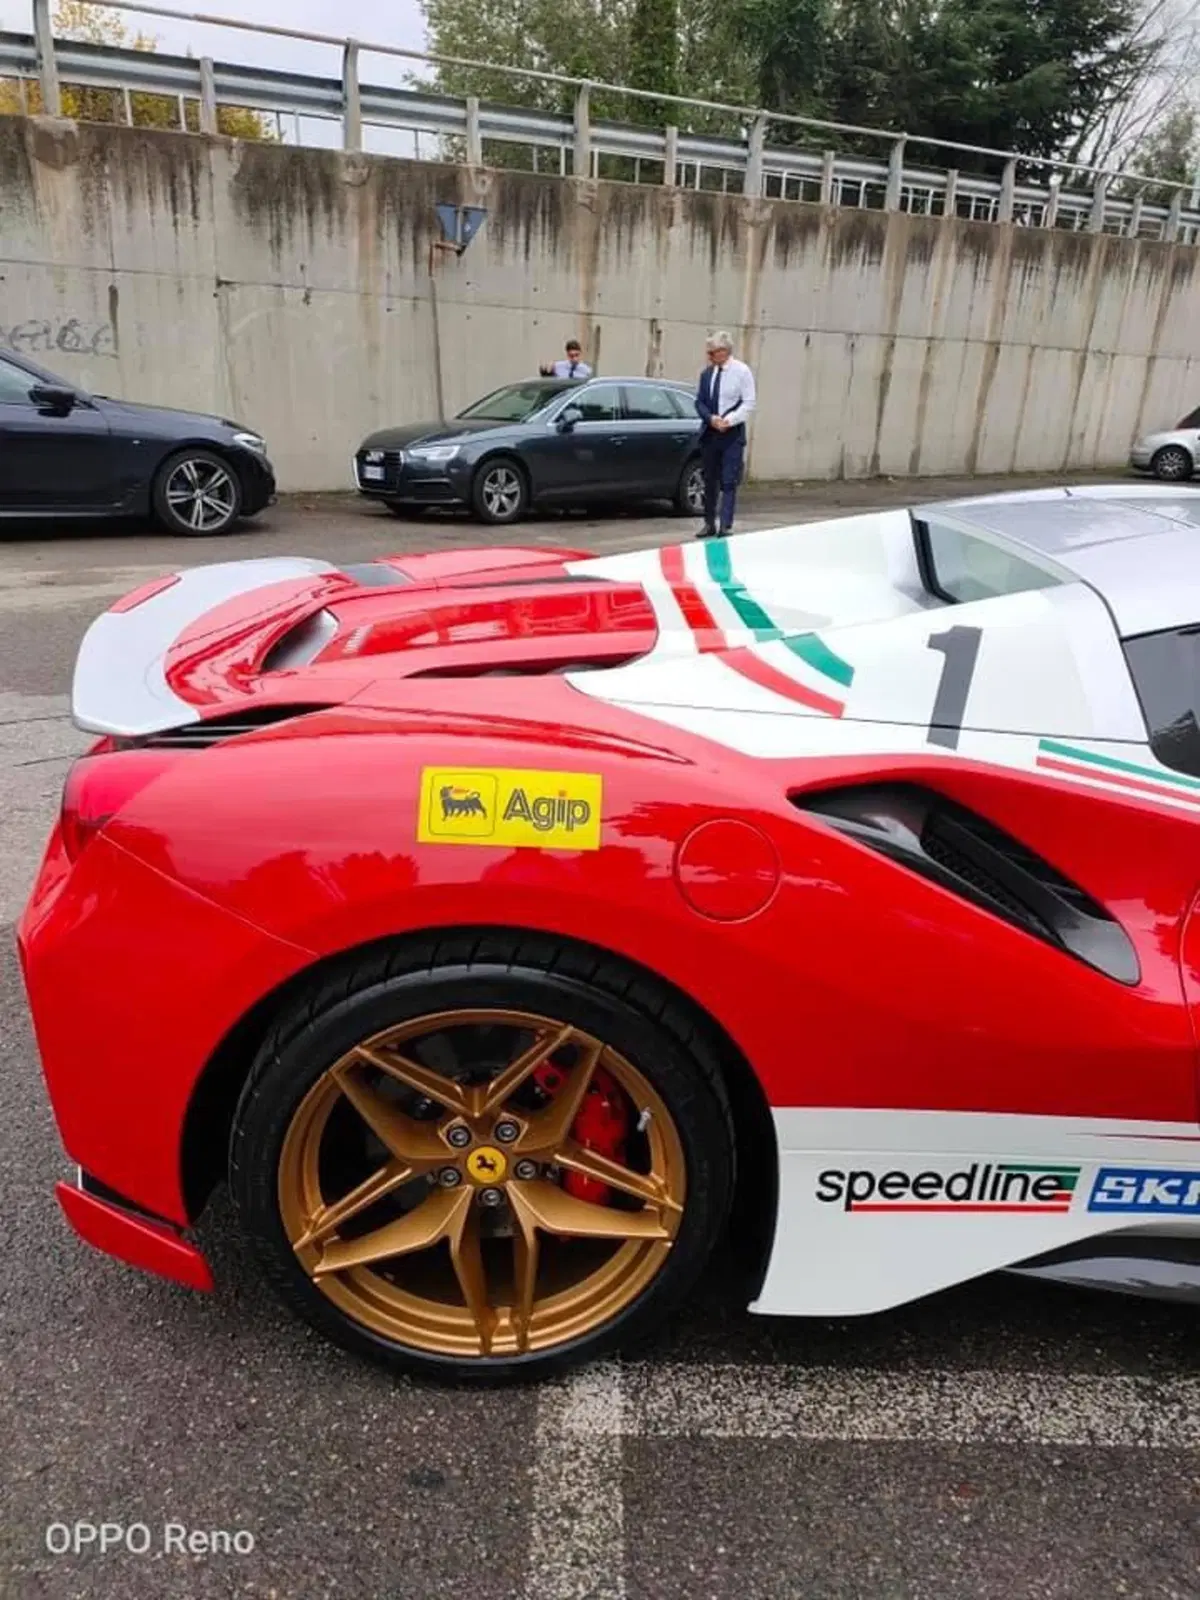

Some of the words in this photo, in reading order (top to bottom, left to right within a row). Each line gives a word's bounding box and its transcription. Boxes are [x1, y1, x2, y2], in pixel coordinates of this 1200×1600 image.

[926, 625, 983, 751] 1
[503, 788, 591, 832] Agip
[816, 1163, 1065, 1212] speedline
